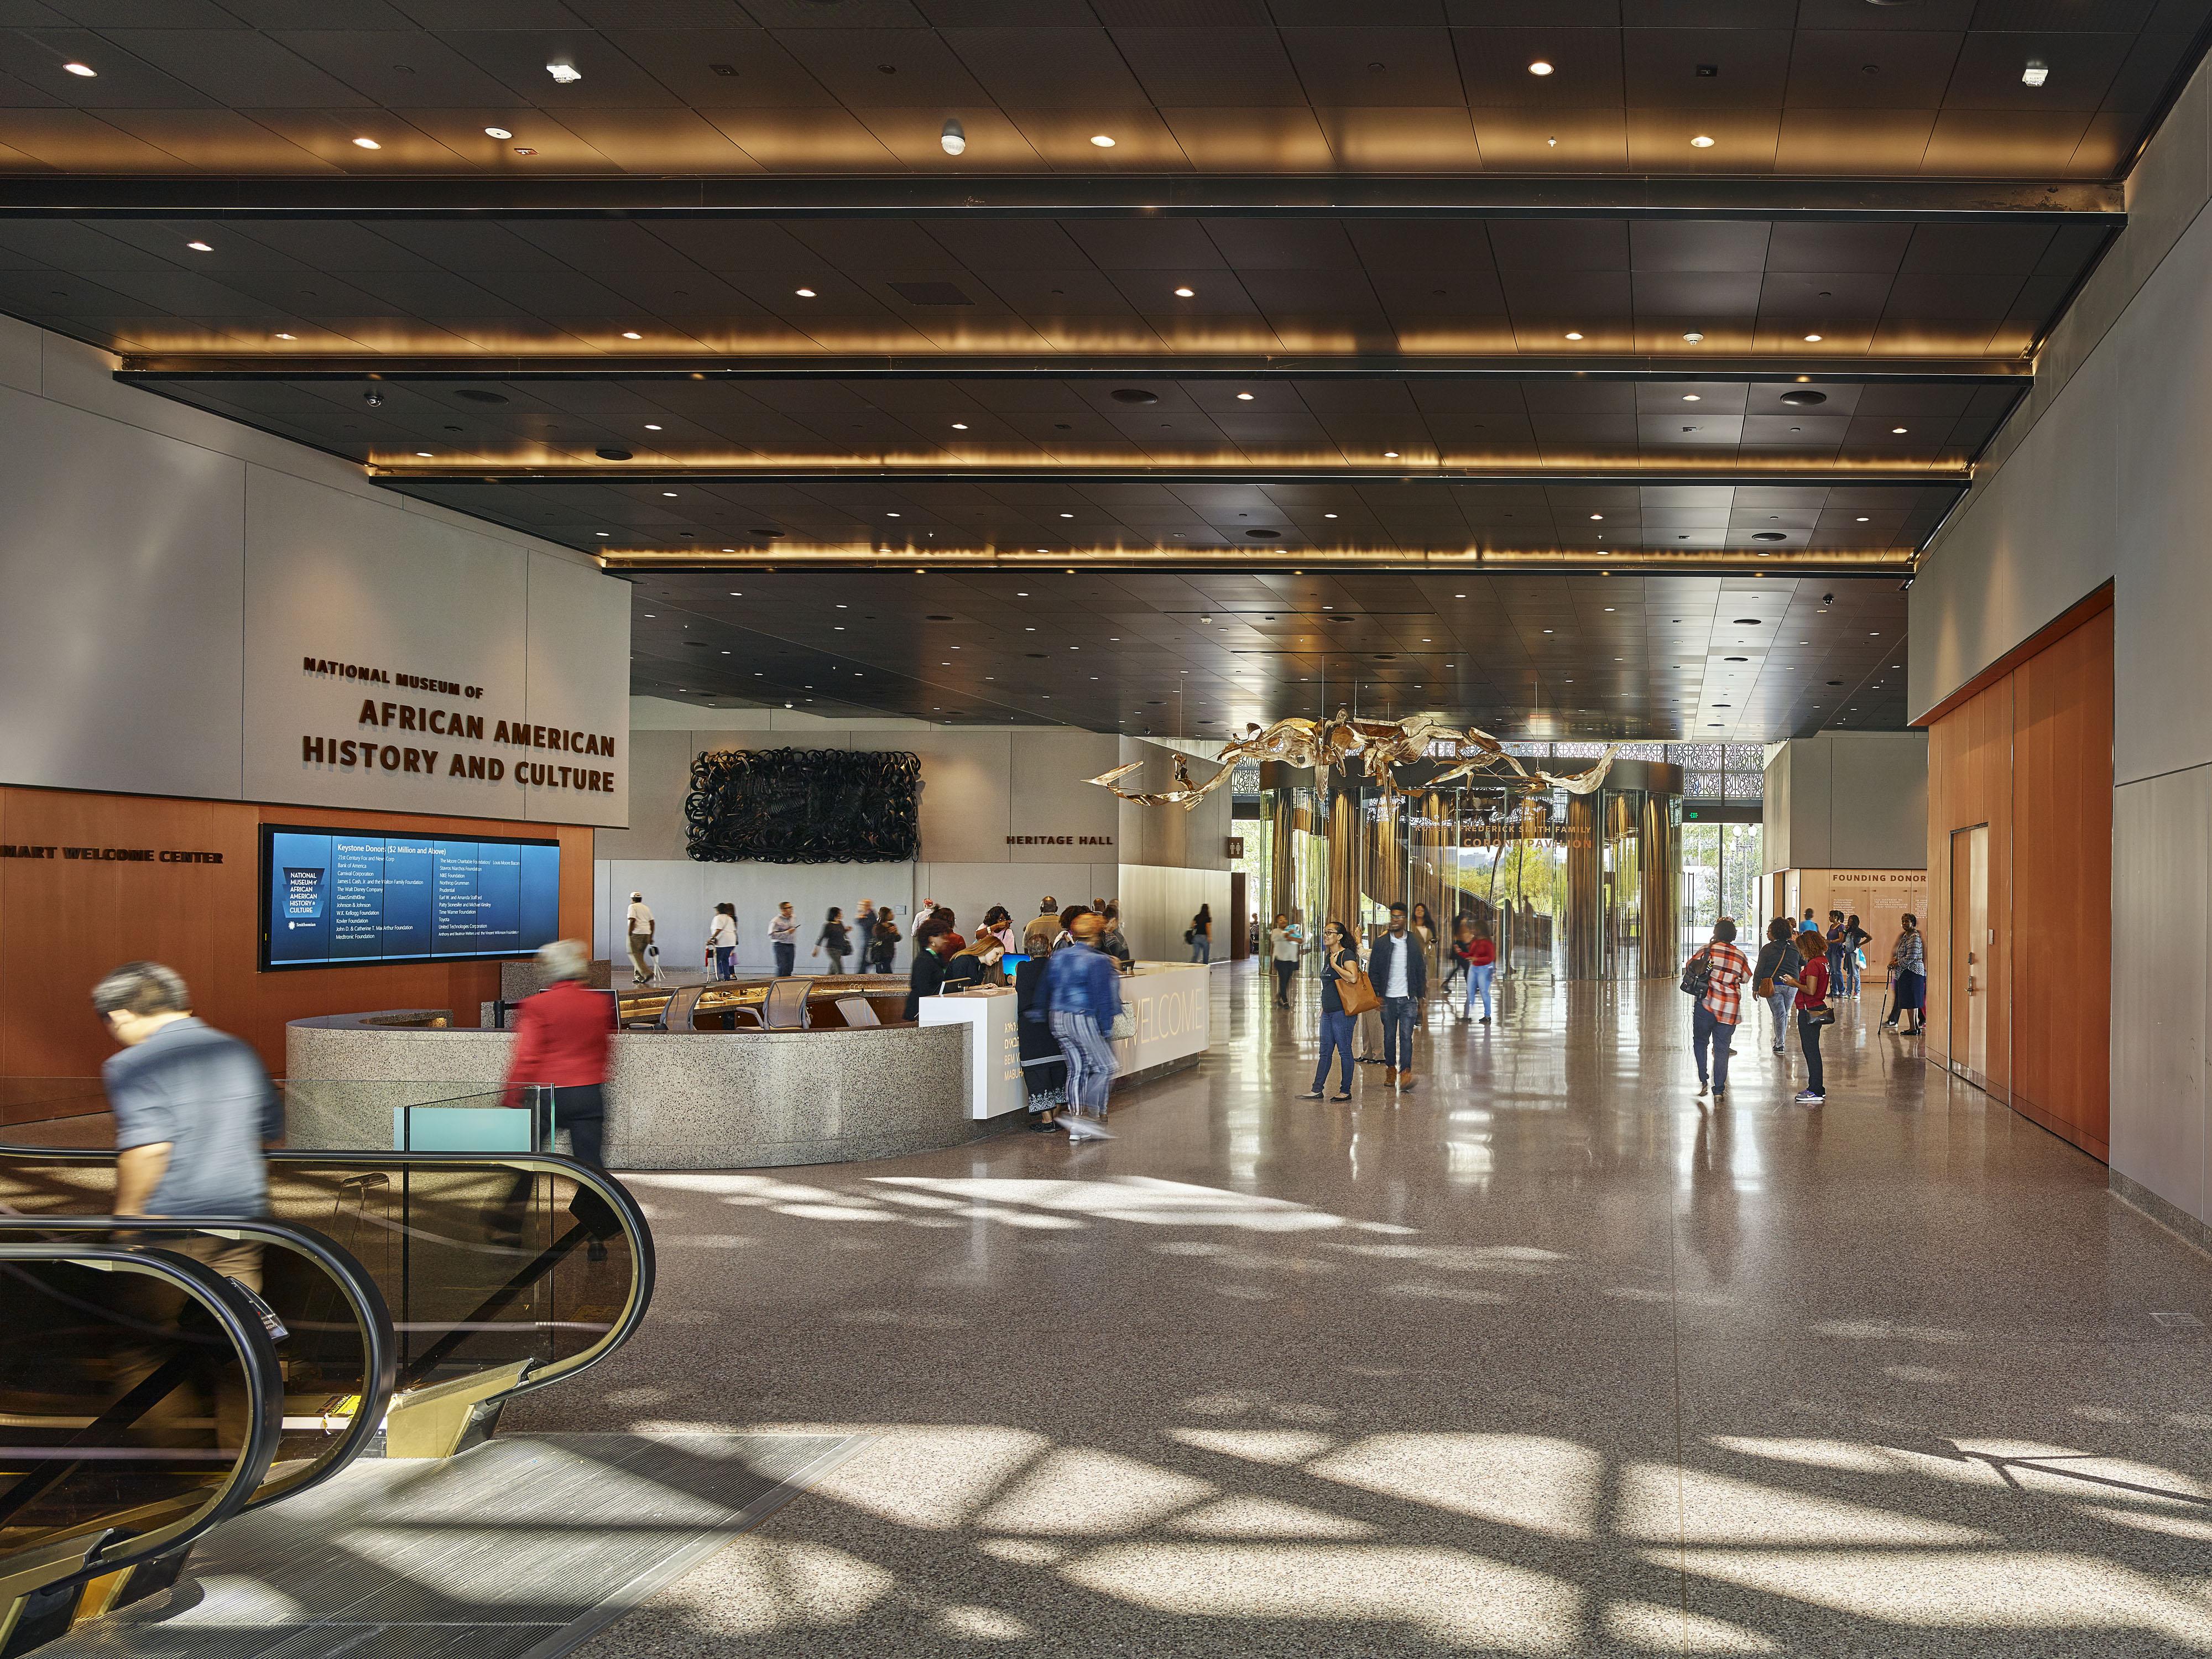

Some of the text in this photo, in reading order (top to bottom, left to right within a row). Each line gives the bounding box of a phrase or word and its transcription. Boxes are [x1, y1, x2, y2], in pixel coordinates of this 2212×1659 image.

[304, 656, 484, 699] NATIONAL MUSEUM OF
[359, 699, 614, 758] AFRICAN AMERICAN
[302, 735, 614, 792] HISTORY AND CULTURE
[1006, 836, 1113, 845] HERITAGE HALL
[1464, 838, 1592, 849] CORONA PAVILION
[61, 847, 155, 862] WELCOME
[159, 850, 223, 864] CENTER
[338, 844, 364, 853] Keystone
[428, 847, 446, 855] Above)
[1004, 1053, 1015, 1065] BEM
